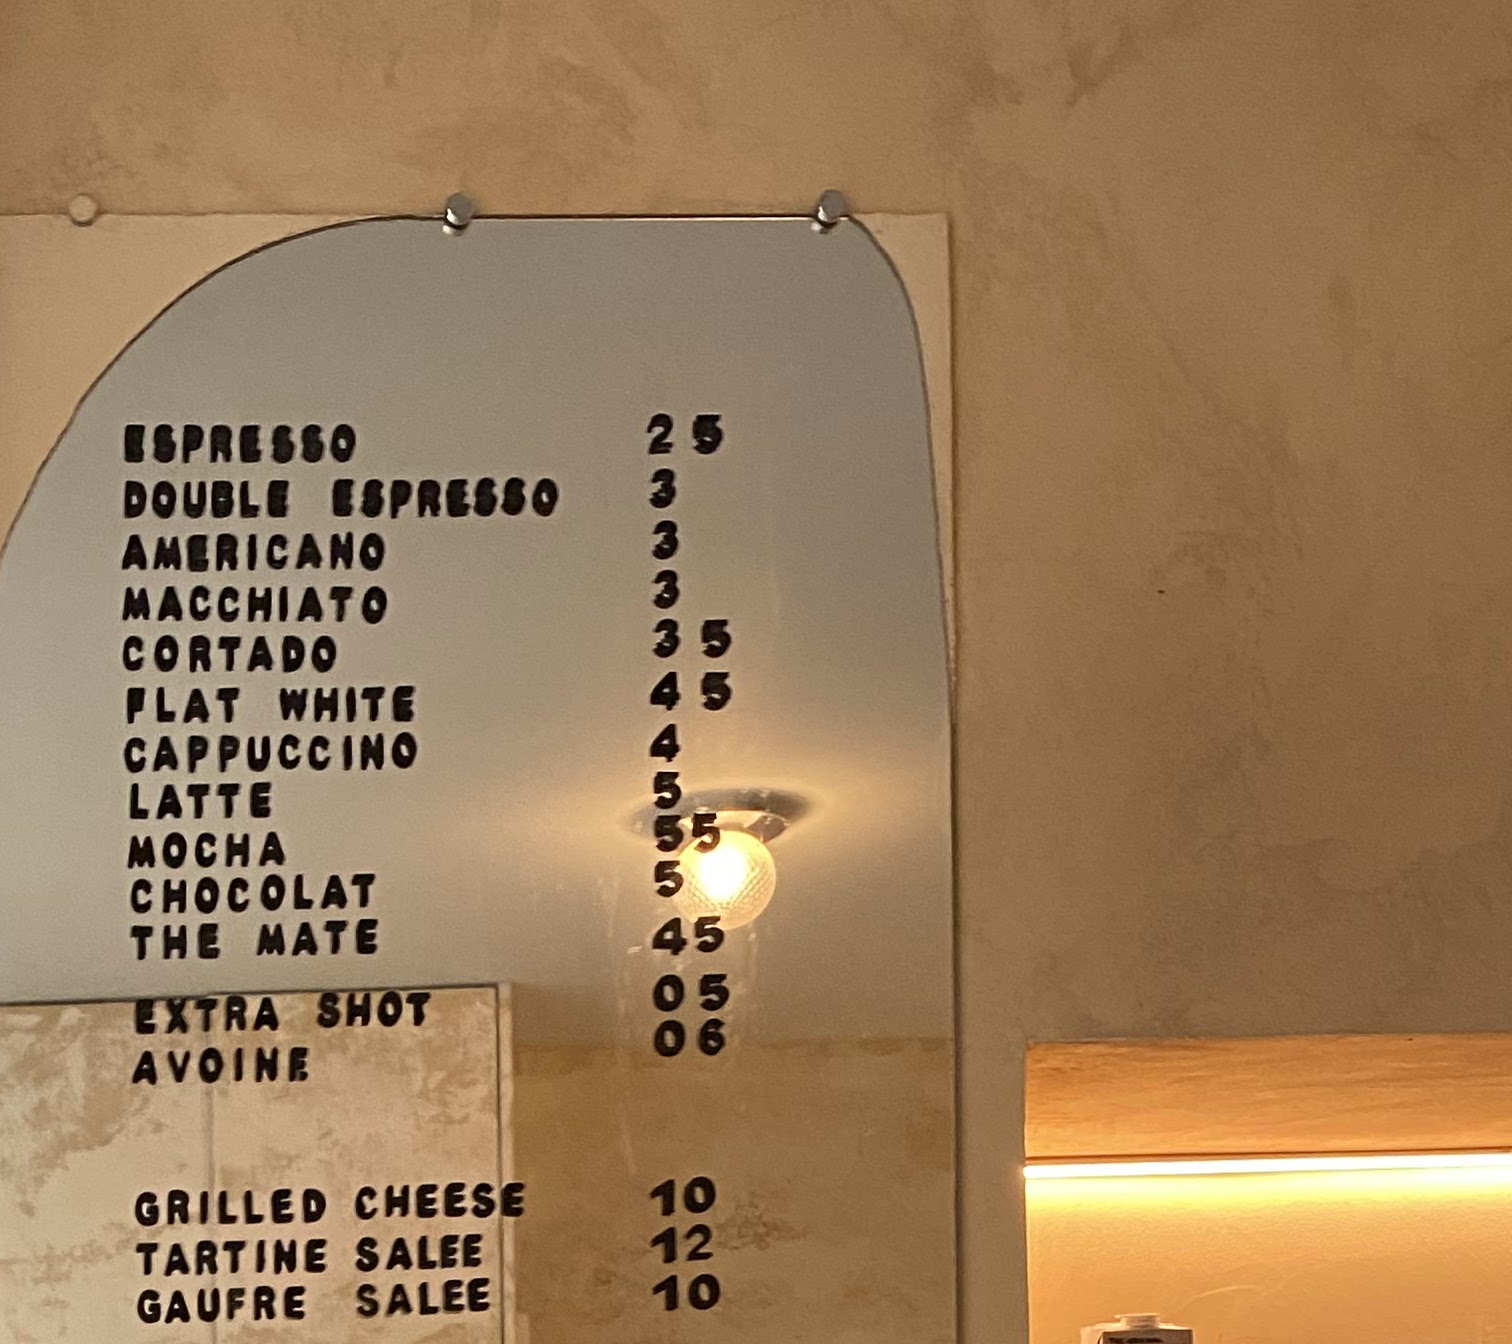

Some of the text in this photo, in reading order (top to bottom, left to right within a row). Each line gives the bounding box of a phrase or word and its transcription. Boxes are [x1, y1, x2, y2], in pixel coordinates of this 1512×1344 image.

[123, 424, 357, 463] ESPRESSO
[123, 469, 677, 519] DOUBLE ESPRESSO 3
[122, 521, 679, 572] AMERICANO 3
[122, 570, 680, 623] MACCHIATO 3
[122, 636, 337, 672] CORTADO
[126, 687, 240, 724] FLAT
[278, 685, 416, 723] WHITE
[123, 723, 680, 773] CAPPUCCINO 4
[129, 771, 682, 820] LATTE 5
[127, 831, 287, 869] MOCHA
[129, 860, 684, 914] CHOCOLAT 5
[130, 922, 220, 960] THE
[257, 919, 379, 956] MATE
[134, 997, 280, 1034] EXTRA
[317, 992, 430, 1028] SHOT
[132, 1047, 309, 1084] AVOINE
[134, 1176, 717, 1228] GRILLED CHEESE 10
[136, 1224, 713, 1276] TARTINE SALEE 12
[136, 1272, 722, 1324] GAUFRE SALEE 10
